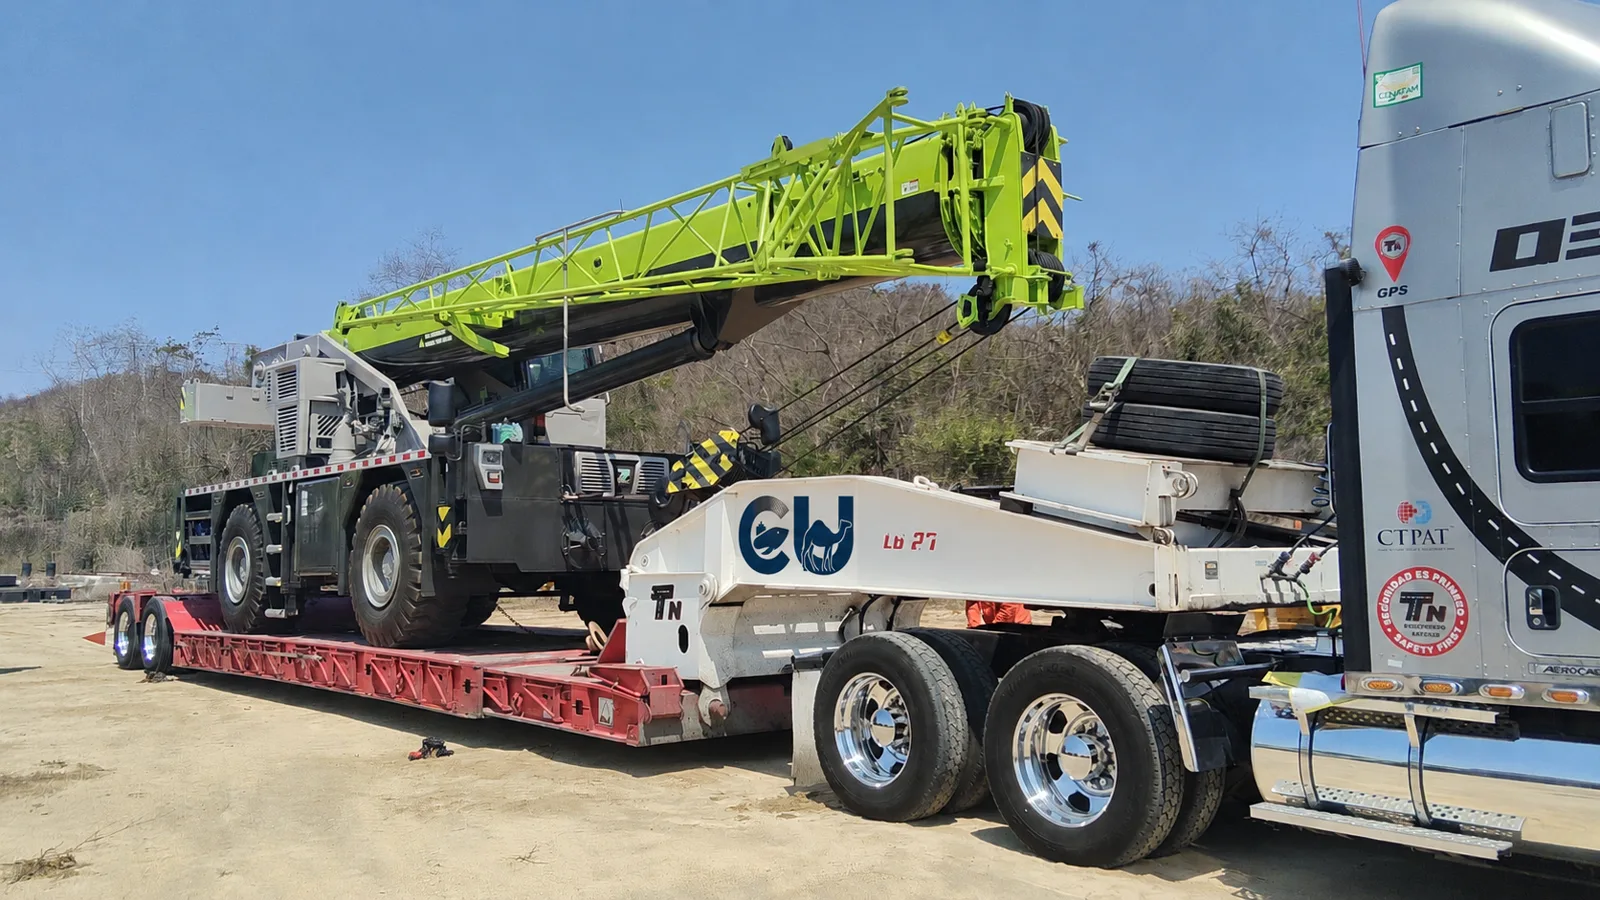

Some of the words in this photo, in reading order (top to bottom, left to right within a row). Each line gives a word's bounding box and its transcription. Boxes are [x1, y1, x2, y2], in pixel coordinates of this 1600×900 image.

[1377, 285, 1408, 298] GPS
[911, 532, 937, 551] 27
[1377, 528, 1449, 546] CTPAT
[1415, 570, 1430, 579] ES
[1394, 633, 1434, 654] SAFETY
